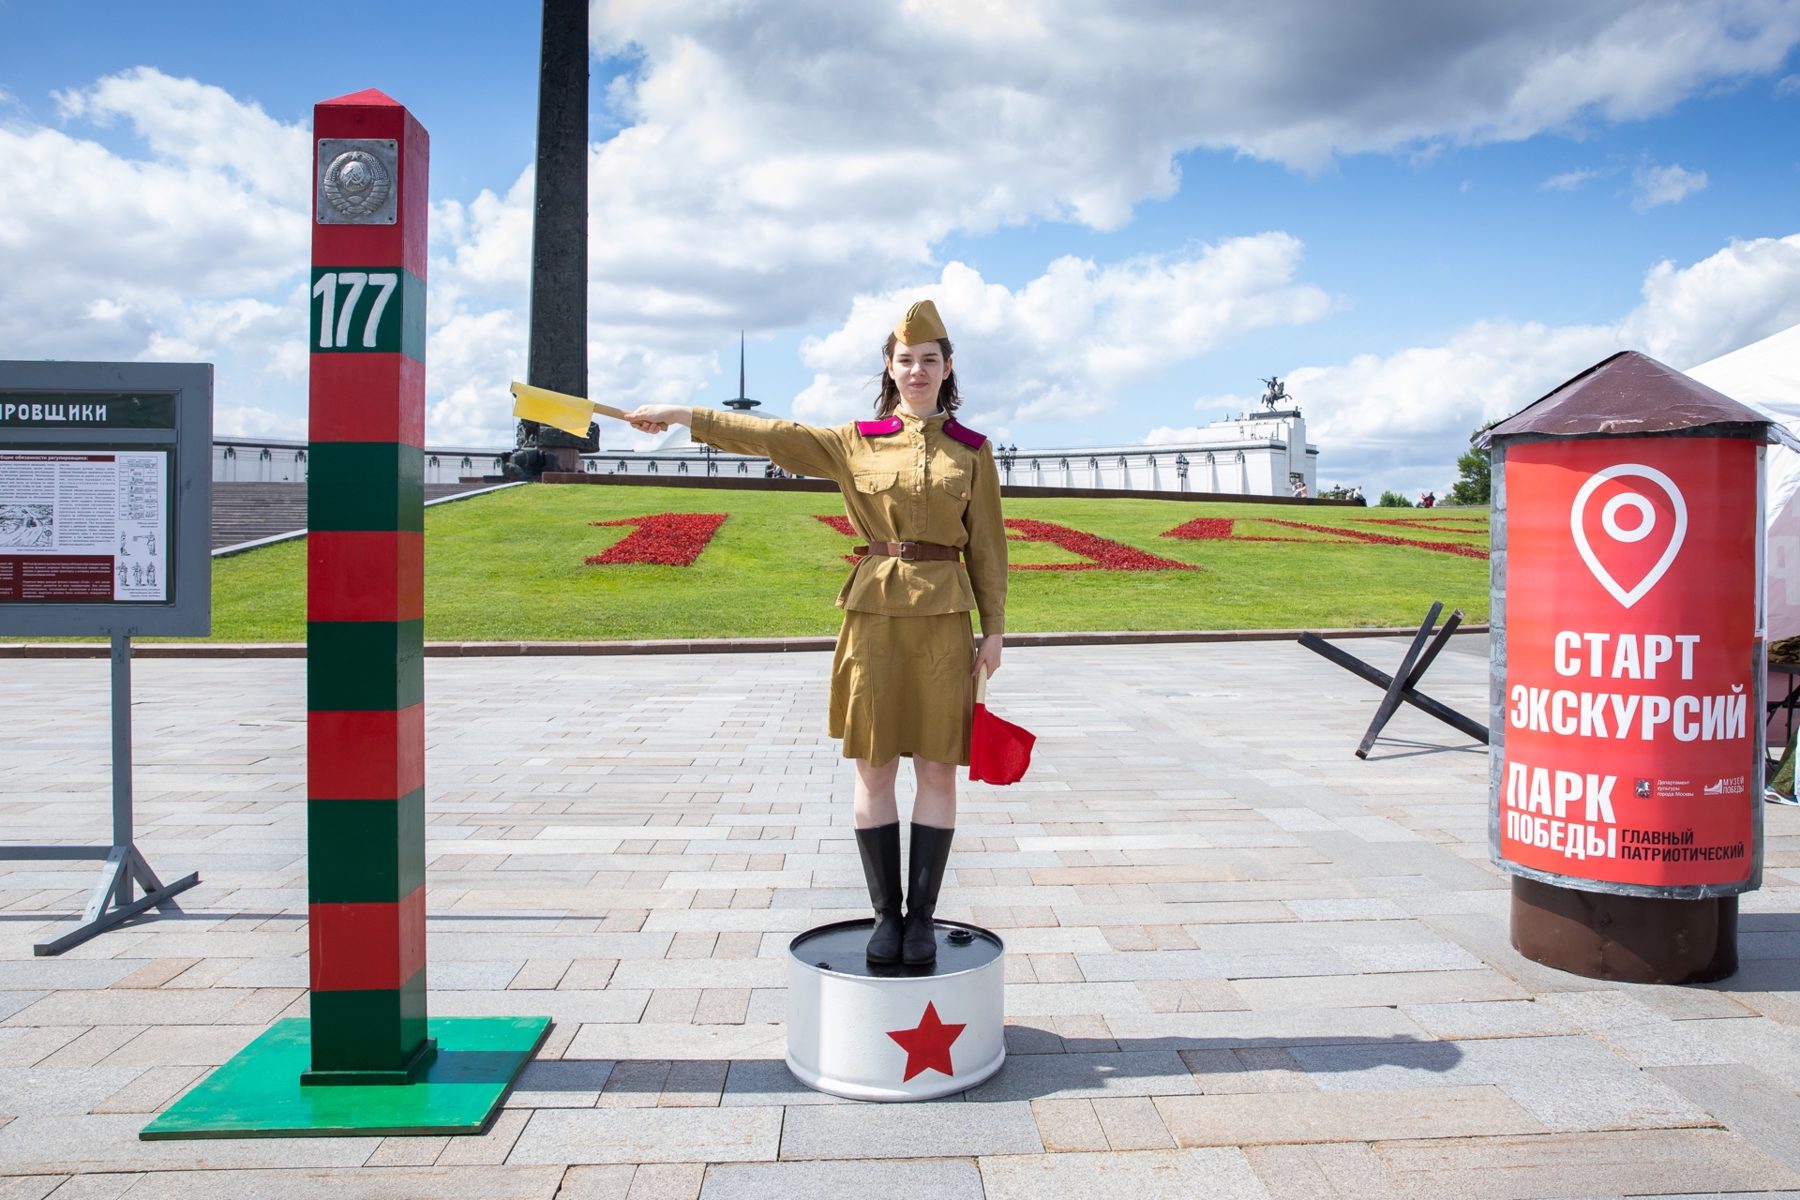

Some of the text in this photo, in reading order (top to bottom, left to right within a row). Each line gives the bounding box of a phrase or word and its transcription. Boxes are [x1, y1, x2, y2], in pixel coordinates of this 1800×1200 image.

[313, 272, 398, 348] 177
[1554, 630, 1700, 680] СТАРТ
[1510, 683, 1747, 741] ЭКСКУРСИЙ
[1507, 761, 1617, 823] ПАРК
[1723, 776, 1744, 786] МУЗЕЙ
[1723, 785, 1744, 794] ПОБЕДЫ
[1507, 810, 1617, 860] ПОБЕДЫ
[1621, 841, 1745, 862] ПАТРИОТИЧЕСКИЙ
[1622, 828, 1694, 846] ГЛАВНЫЙ
